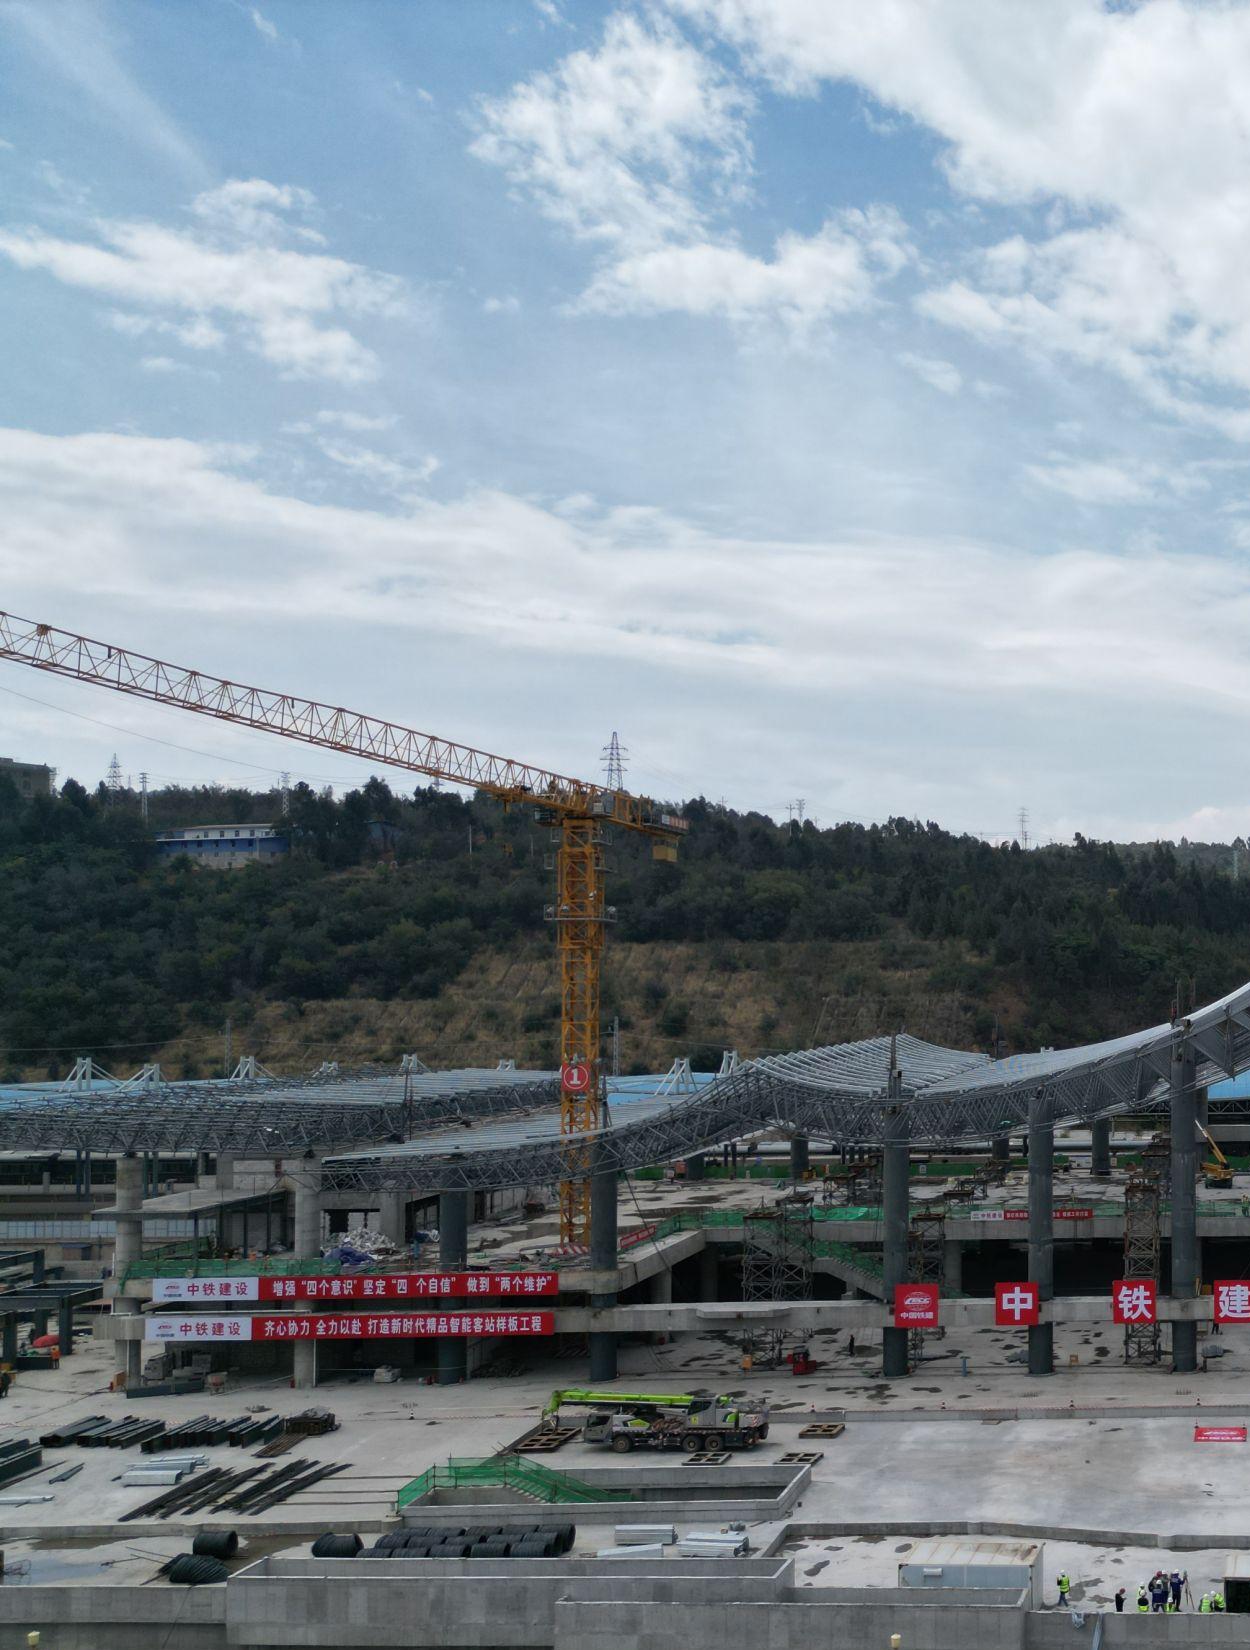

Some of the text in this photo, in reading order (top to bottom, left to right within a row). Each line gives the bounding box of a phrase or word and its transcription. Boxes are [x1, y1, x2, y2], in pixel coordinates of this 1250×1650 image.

[570, 1068, 581, 1085] 1
[187, 1282, 248, 1296] 中铁建设
[180, 1322, 241, 1336] 中铁建设
[265, 1316, 542, 1337] 齐心协力 全力以赴 打造新时代精品智能客站样板工程
